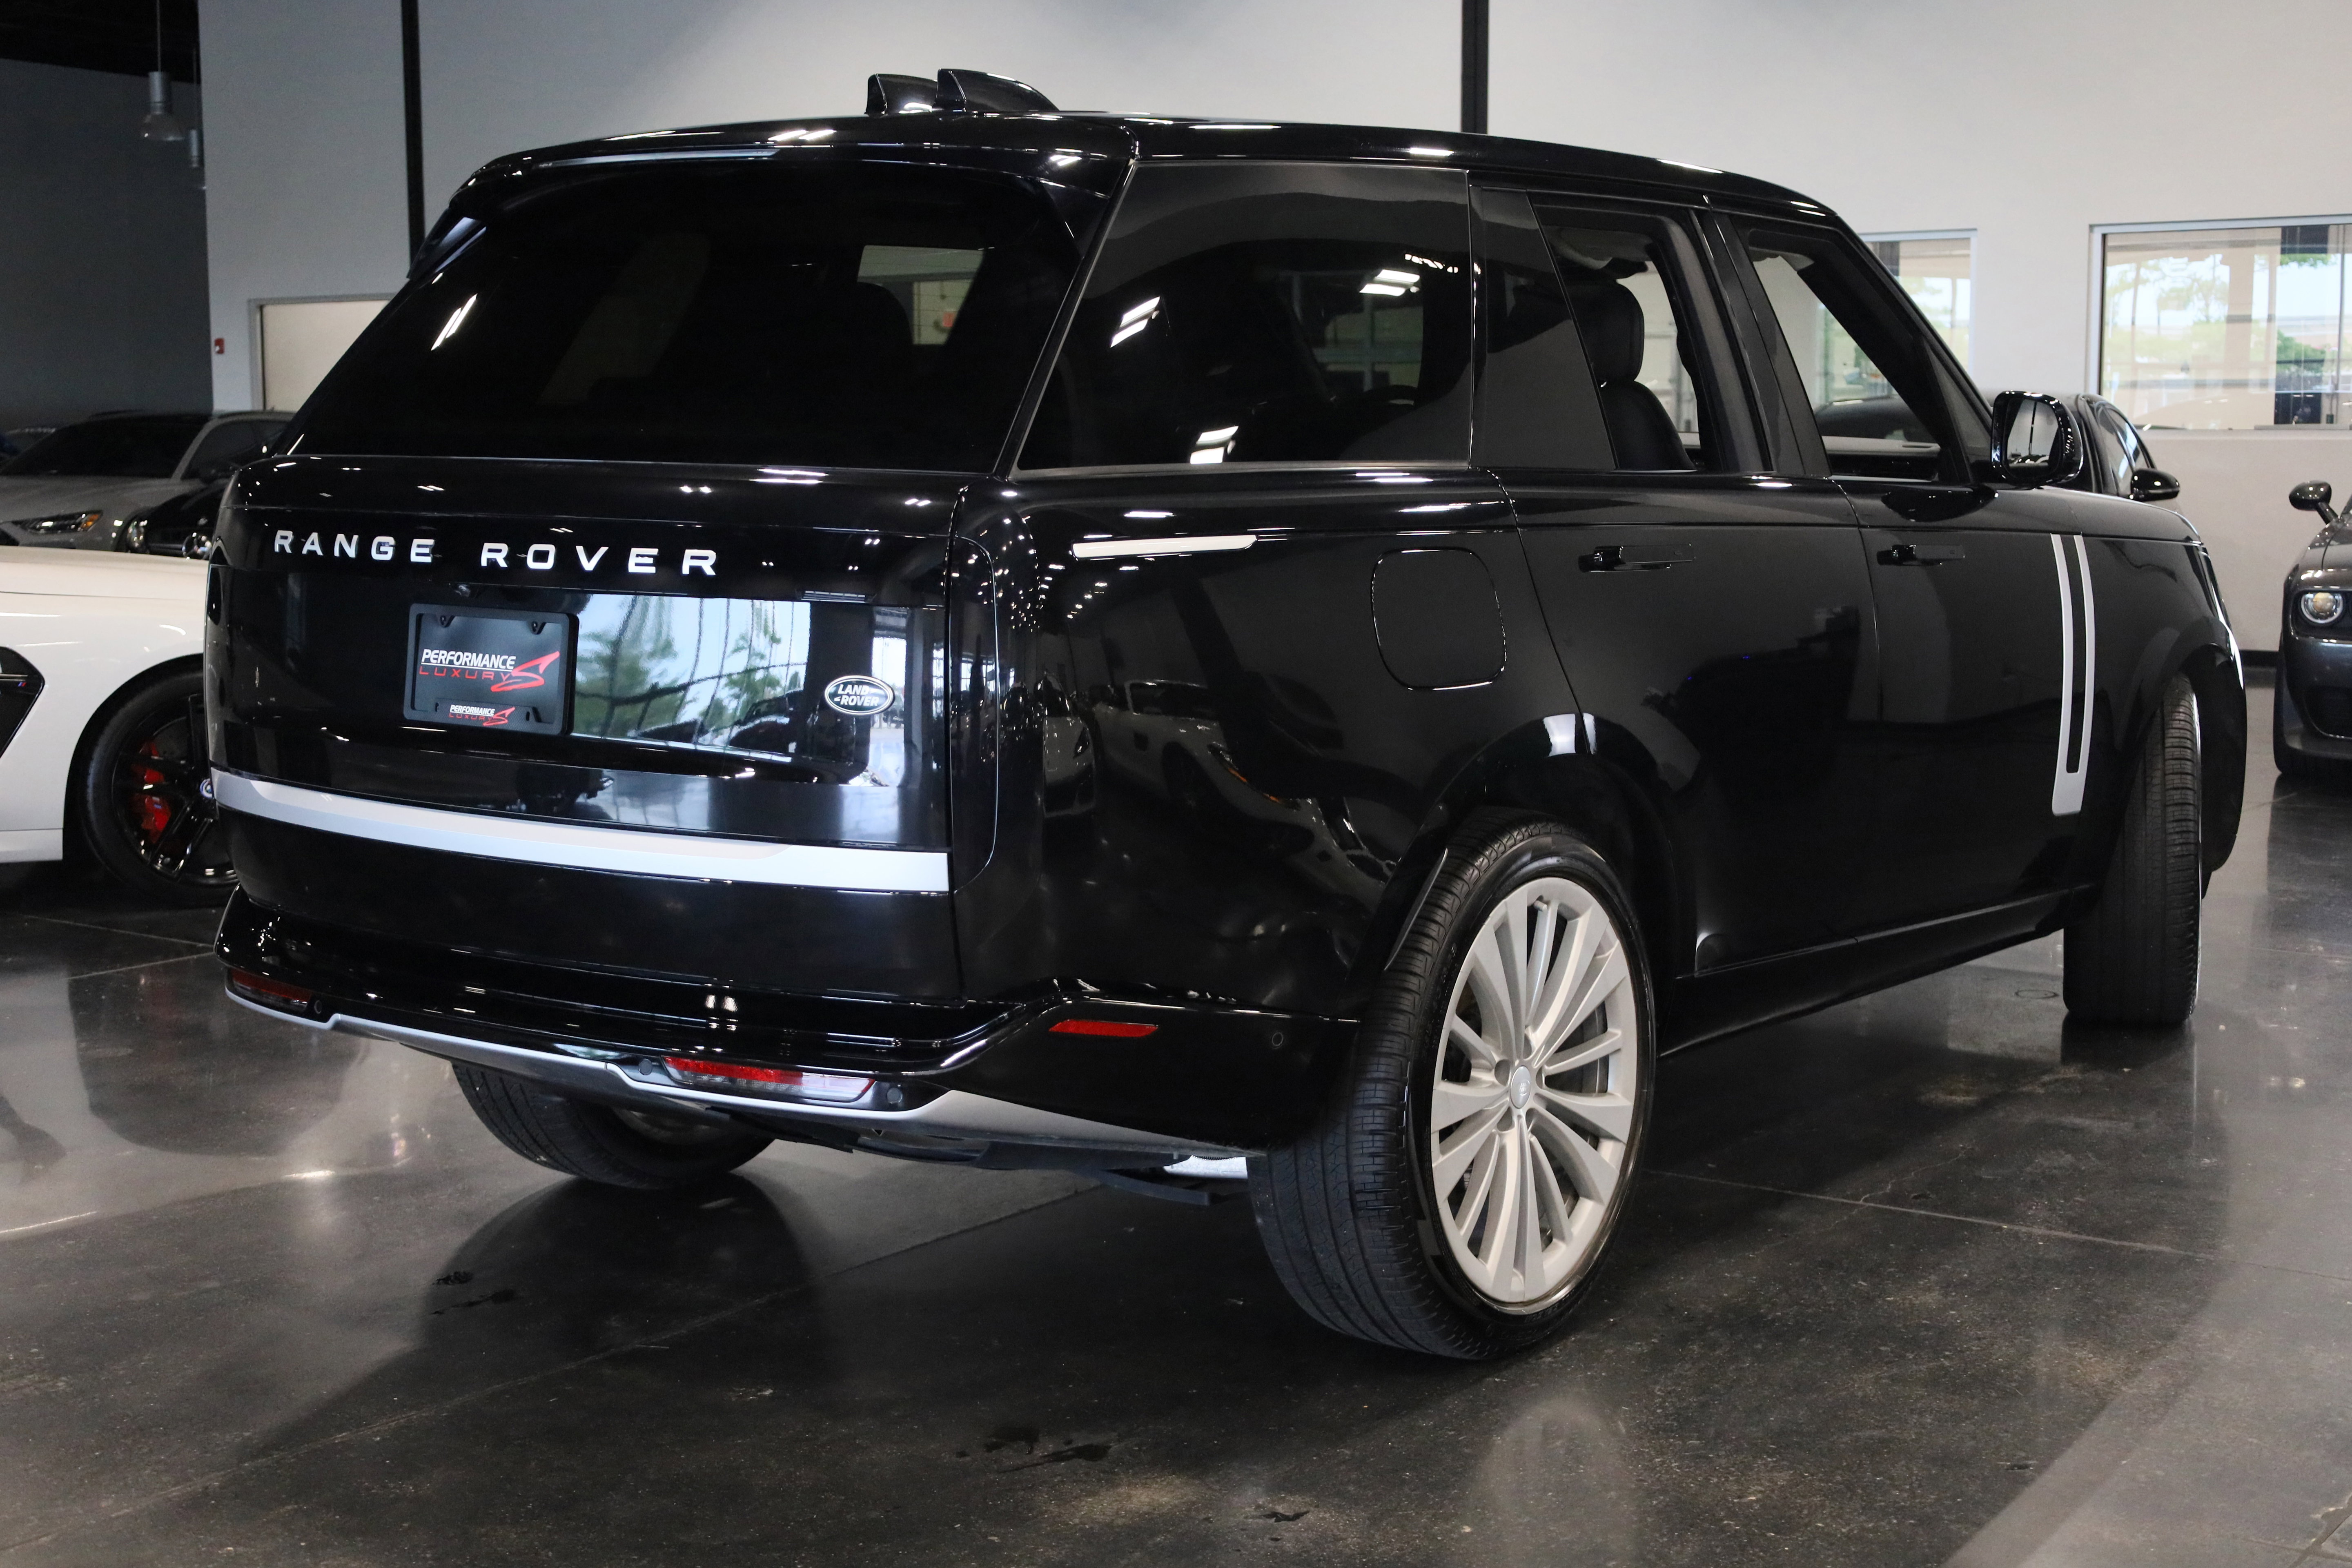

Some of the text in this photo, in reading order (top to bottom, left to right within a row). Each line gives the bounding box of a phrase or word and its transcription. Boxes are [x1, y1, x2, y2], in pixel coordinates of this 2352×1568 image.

[274, 530, 717, 576] RANGE ROVER
[421, 648, 516, 670] PERFORMANCE
[419, 666, 511, 681] LUXURY
[837, 684, 870, 695] LAND
[840, 695, 879, 706] ROVER
[450, 704, 495, 715] PERFORMANCE
